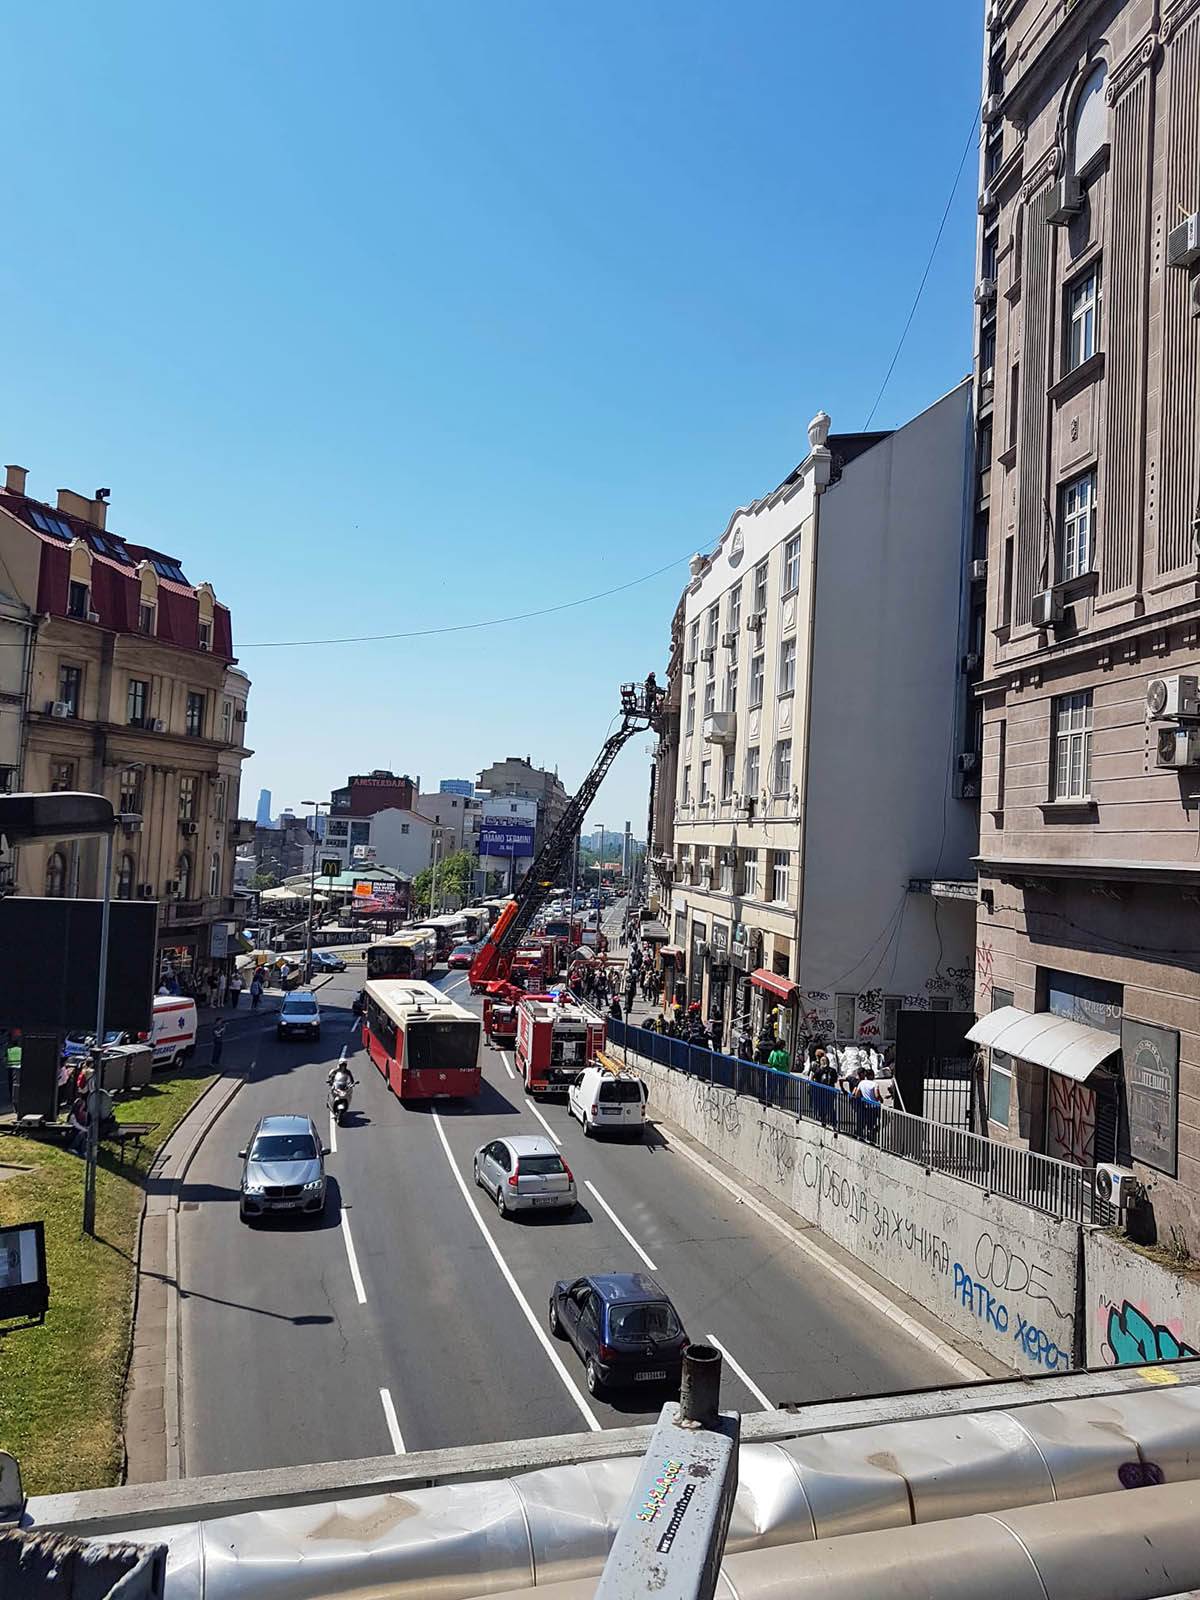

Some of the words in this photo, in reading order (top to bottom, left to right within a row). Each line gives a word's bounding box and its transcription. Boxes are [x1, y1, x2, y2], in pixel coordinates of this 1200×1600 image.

[354, 778, 406, 788] AMSTERDAM
[483, 833, 505, 843] IMAMO
[802, 1152, 869, 1225] СЛОБОДА
[873, 1201, 889, 1241] ЗА
[975, 1233, 1058, 1301] CODE
